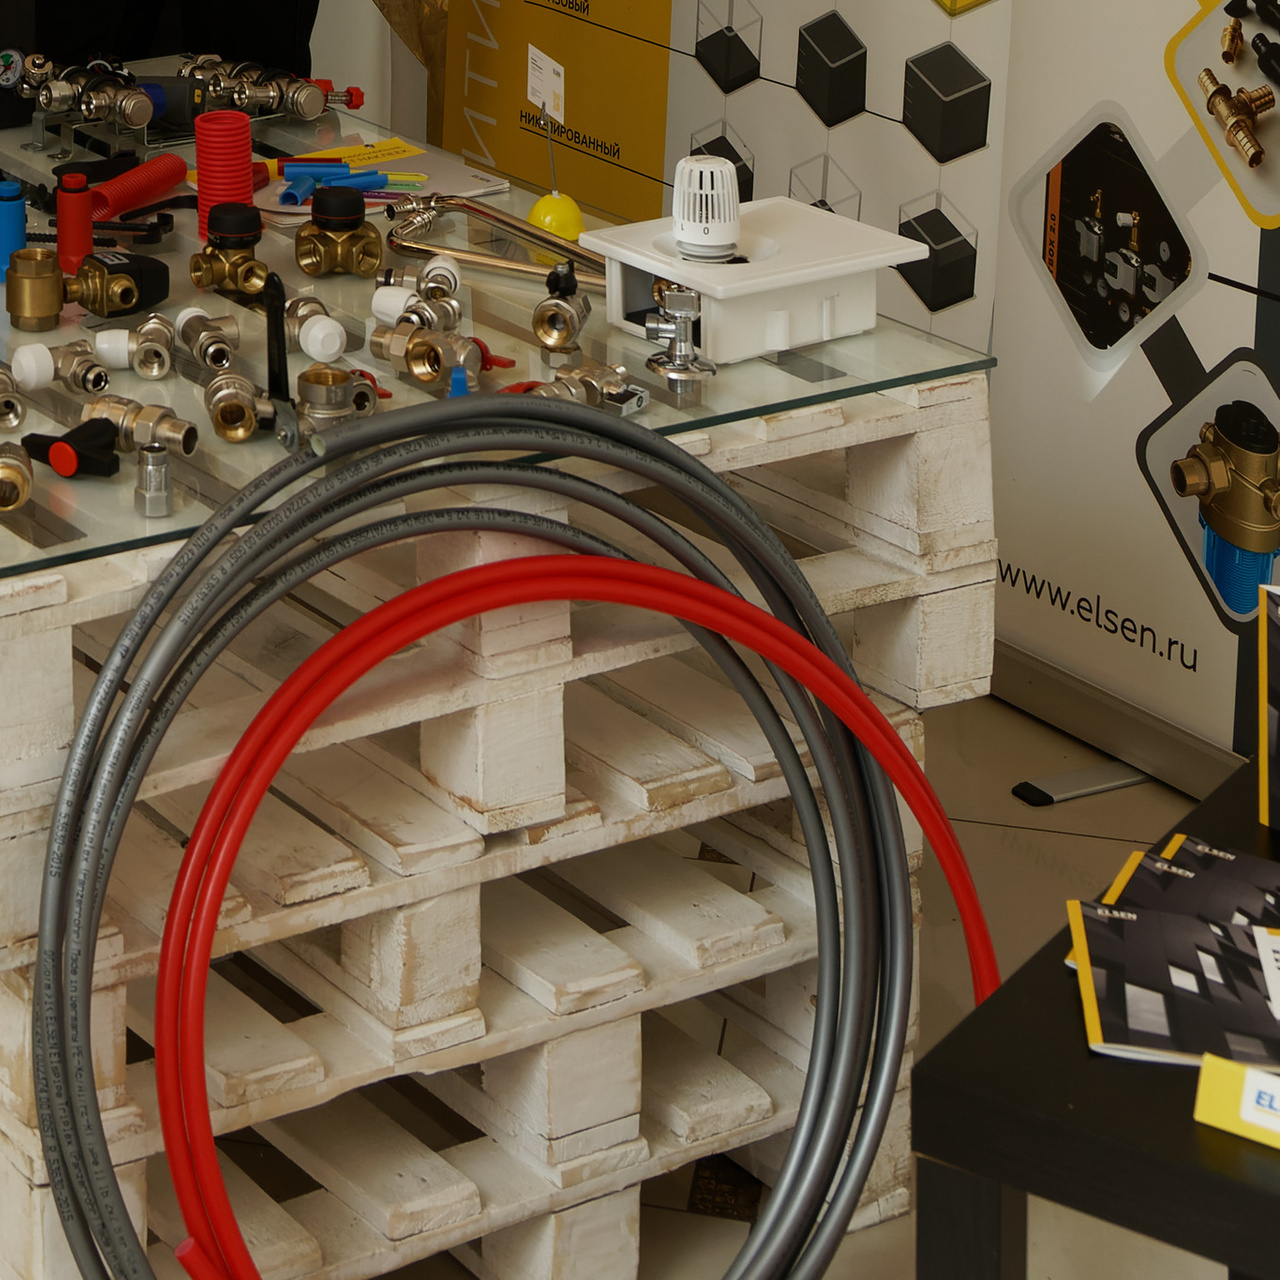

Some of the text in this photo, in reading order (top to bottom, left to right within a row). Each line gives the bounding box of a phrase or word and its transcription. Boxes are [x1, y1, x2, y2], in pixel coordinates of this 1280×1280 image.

[190, 531, 210, 551] DIN
[174, 546, 197, 570] 4726
[223, 543, 248, 568] GOST
[176, 572, 221, 625] 53630-2015
[997, 558, 1200, 676] www.elsen.ru
[48, 811, 71, 877] 53630-2015
[1195, 843, 1237, 862] ELSEN
[1154, 860, 1196, 880] ELSEN
[1096, 907, 1139, 921] ELSEN
